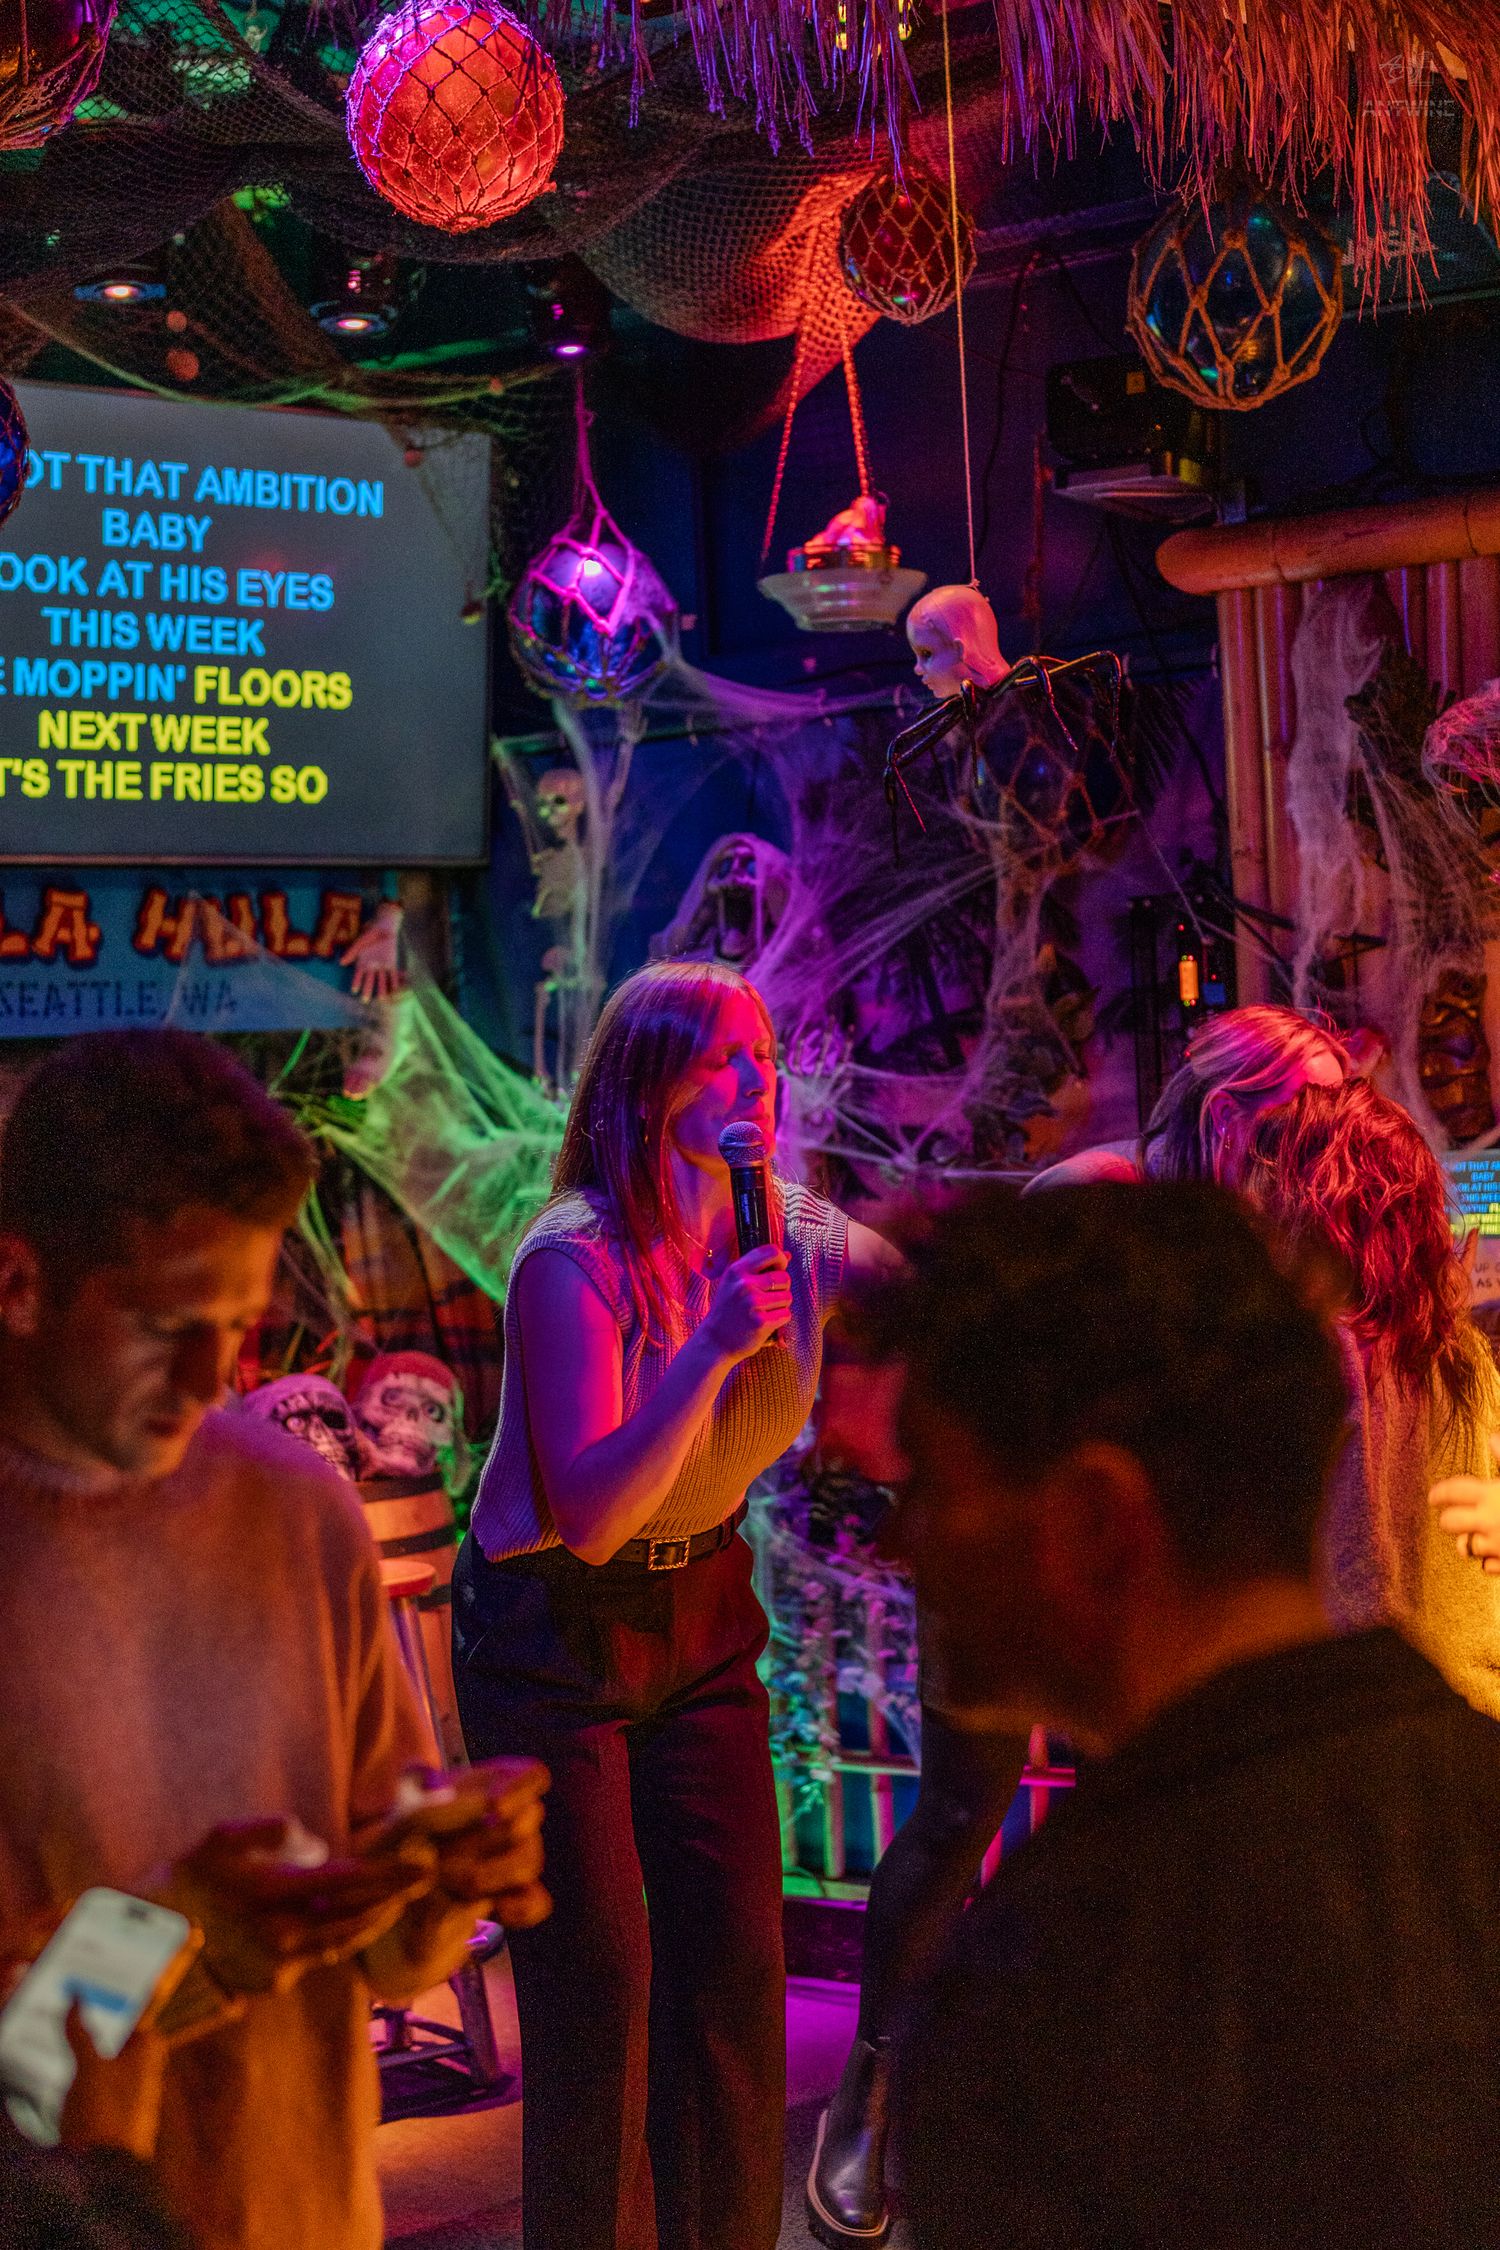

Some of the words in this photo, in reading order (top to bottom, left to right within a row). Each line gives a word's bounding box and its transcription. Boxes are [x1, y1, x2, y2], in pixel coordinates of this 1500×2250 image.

[76, 453, 189, 501] THAT
[194, 465, 385, 518] AMBITION
[102, 508, 213, 553] BABY
[0, 551, 90, 597] OOK
[96, 560, 153, 600] AT
[160, 563, 229, 605] HIS
[237, 569, 335, 612] EYES
[40, 606, 141, 650] THIS
[145, 613, 266, 657] WEEK
[13, 656, 187, 702] MOPPIN'
[194, 665, 353, 710] FLOORS
[38, 710, 148, 752] NEXT
[151, 714, 271, 756] WEEK
[56, 759, 143, 801] THE
[150, 762, 265, 803] FRIES
[271, 765, 328, 804] SO
[133, 887, 363, 966] HULA
